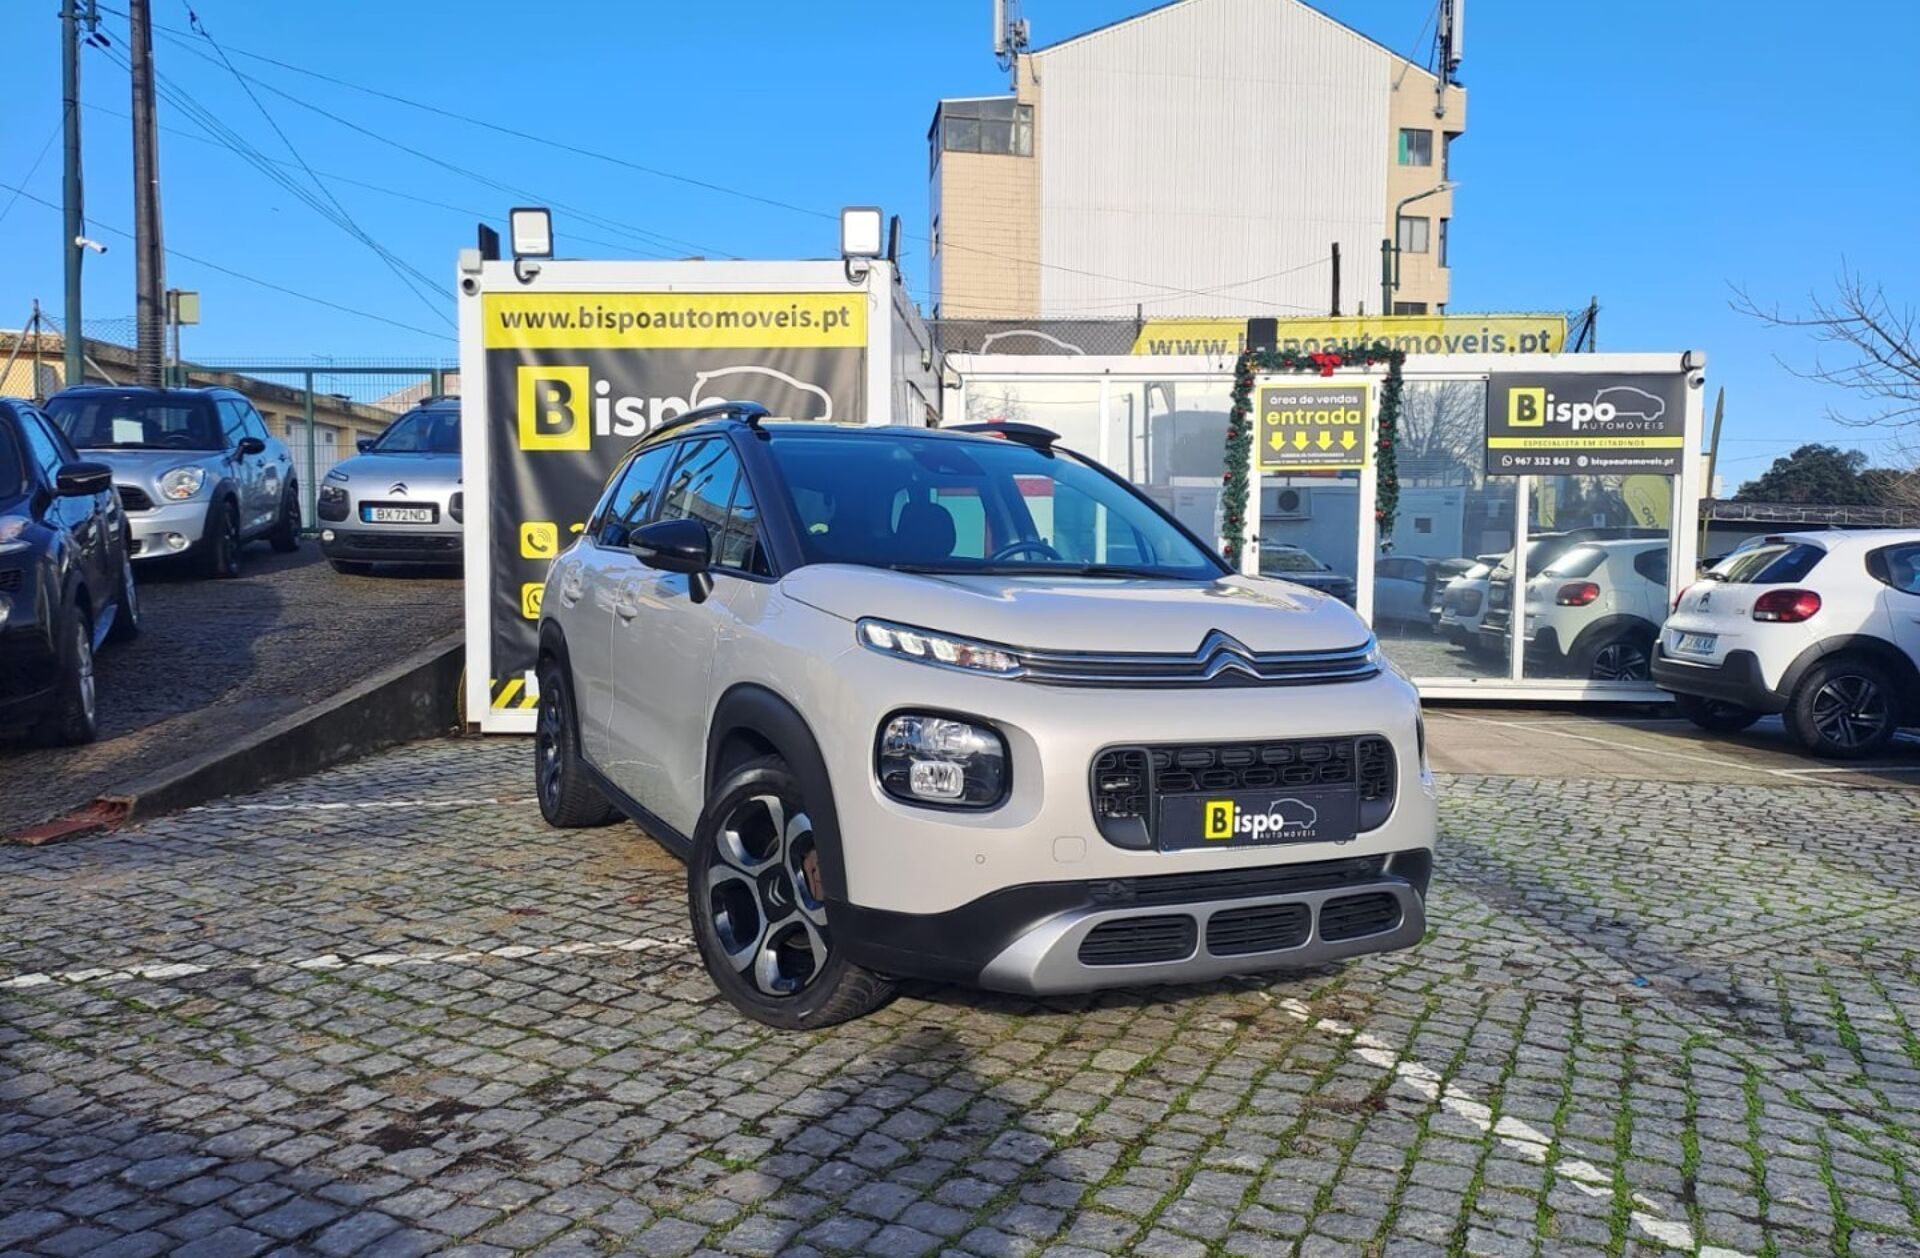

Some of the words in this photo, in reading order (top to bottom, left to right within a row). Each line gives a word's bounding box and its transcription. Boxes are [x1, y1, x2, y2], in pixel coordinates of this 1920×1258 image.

[500, 304, 851, 334] www.bispoautomoveis.pt
[1299, 393, 1314, 405] de
[1316, 394, 1359, 405] vendas
[1266, 406, 1361, 426] entrada
[1516, 394, 1617, 431] Bispo
[1523, 440, 1579, 448] ESPECIALISTA
[1583, 440, 1596, 448] EM
[1599, 440, 1646, 448] CITADINOS
[1514, 456, 1532, 467] 967
[1212, 805, 1285, 840] Bispo
